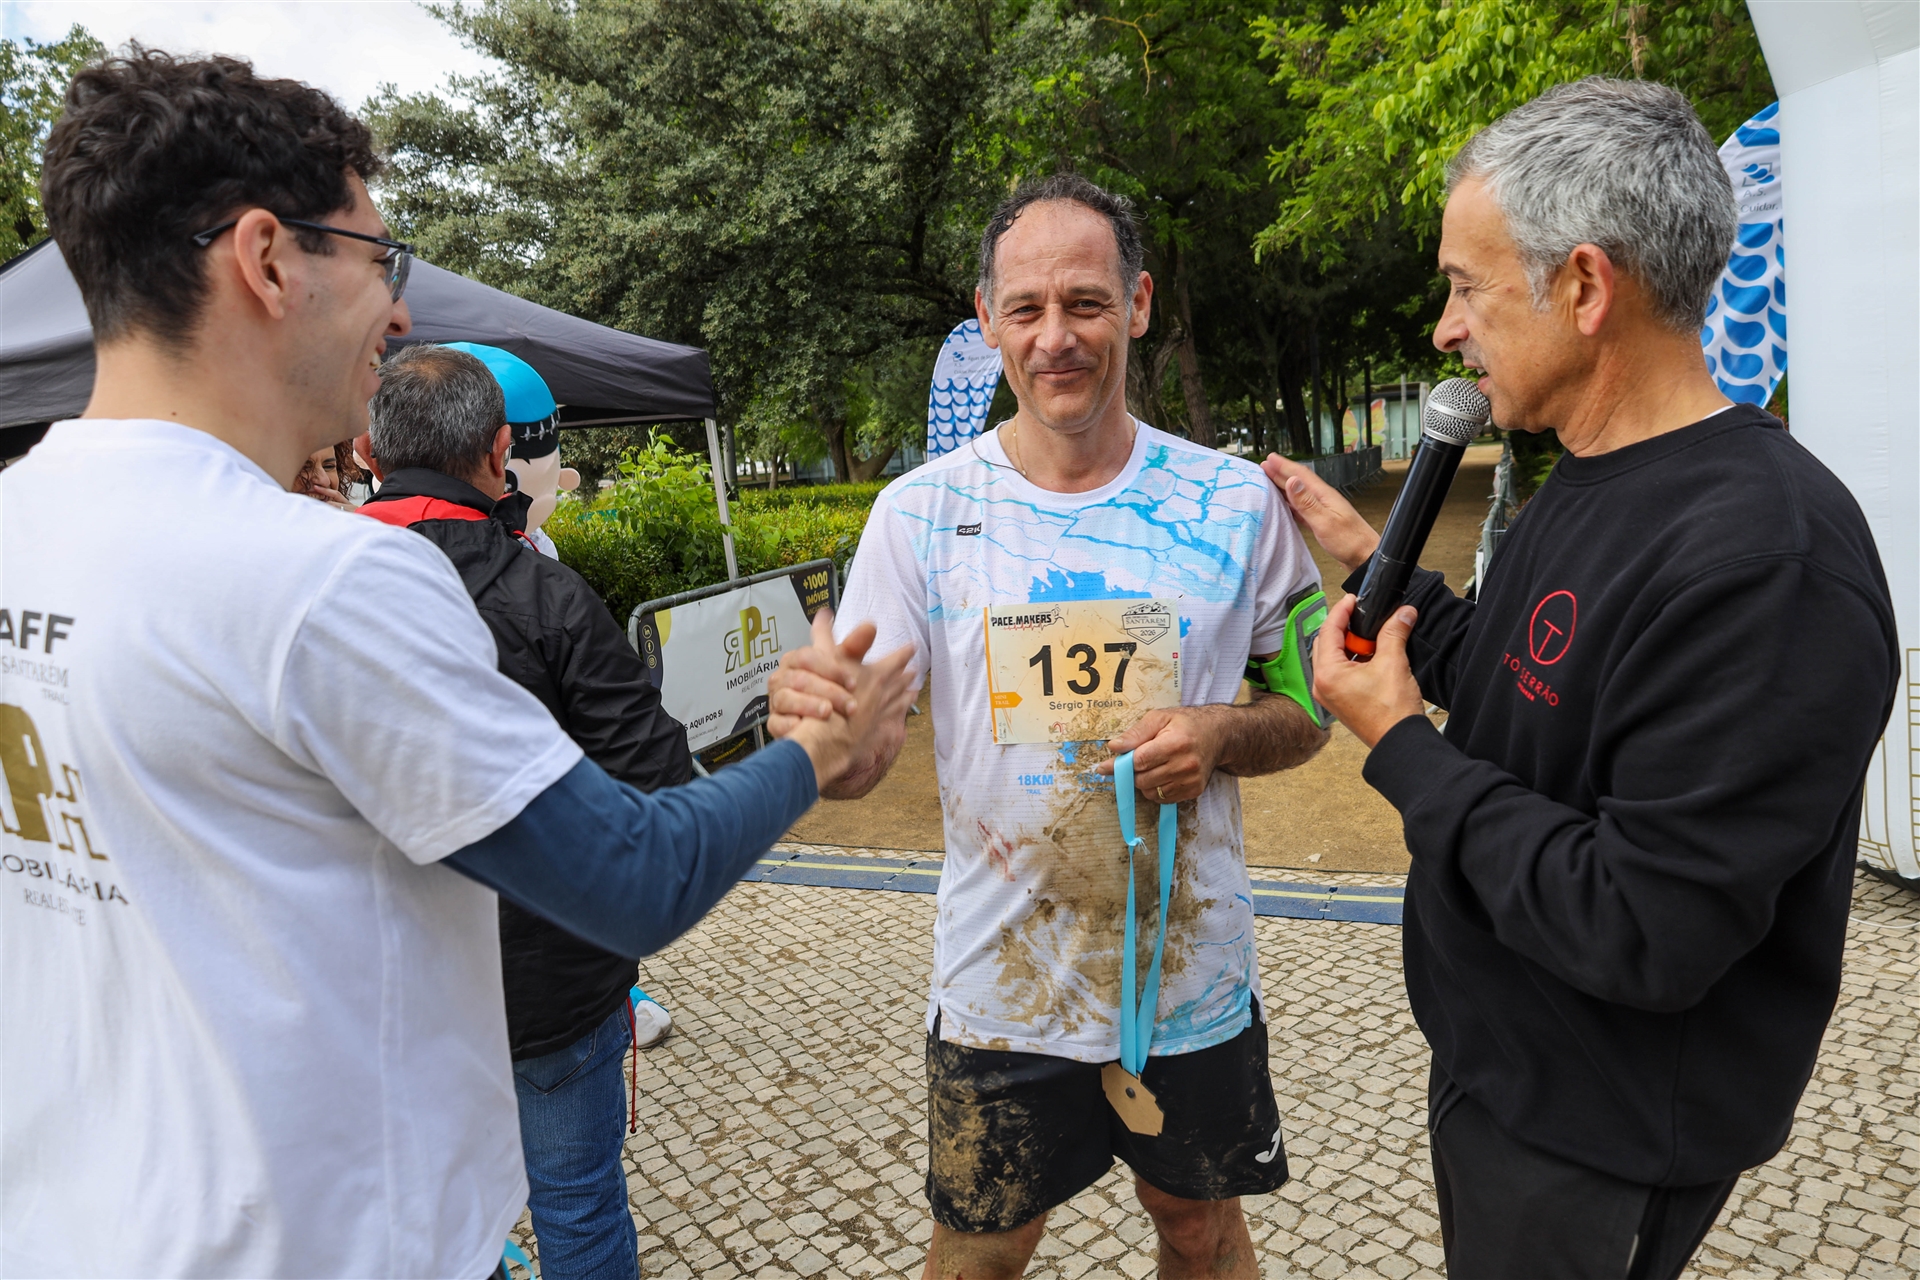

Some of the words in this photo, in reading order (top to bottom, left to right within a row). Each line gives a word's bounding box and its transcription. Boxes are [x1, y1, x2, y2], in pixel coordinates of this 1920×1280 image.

[1743, 188, 1766, 198] A.S.
[1740, 203, 1779, 213] Cuidar.
[803, 570, 828, 590] +1000
[1125, 617, 1166, 625] SANTARÉM
[1029, 641, 1138, 697] 137
[1049, 700, 1084, 711] Sérgio
[689, 717, 705, 730] AQUI
[705, 711, 717, 723] POR
[717, 708, 724, 718] SI
[1017, 773, 1055, 786] 18KM
